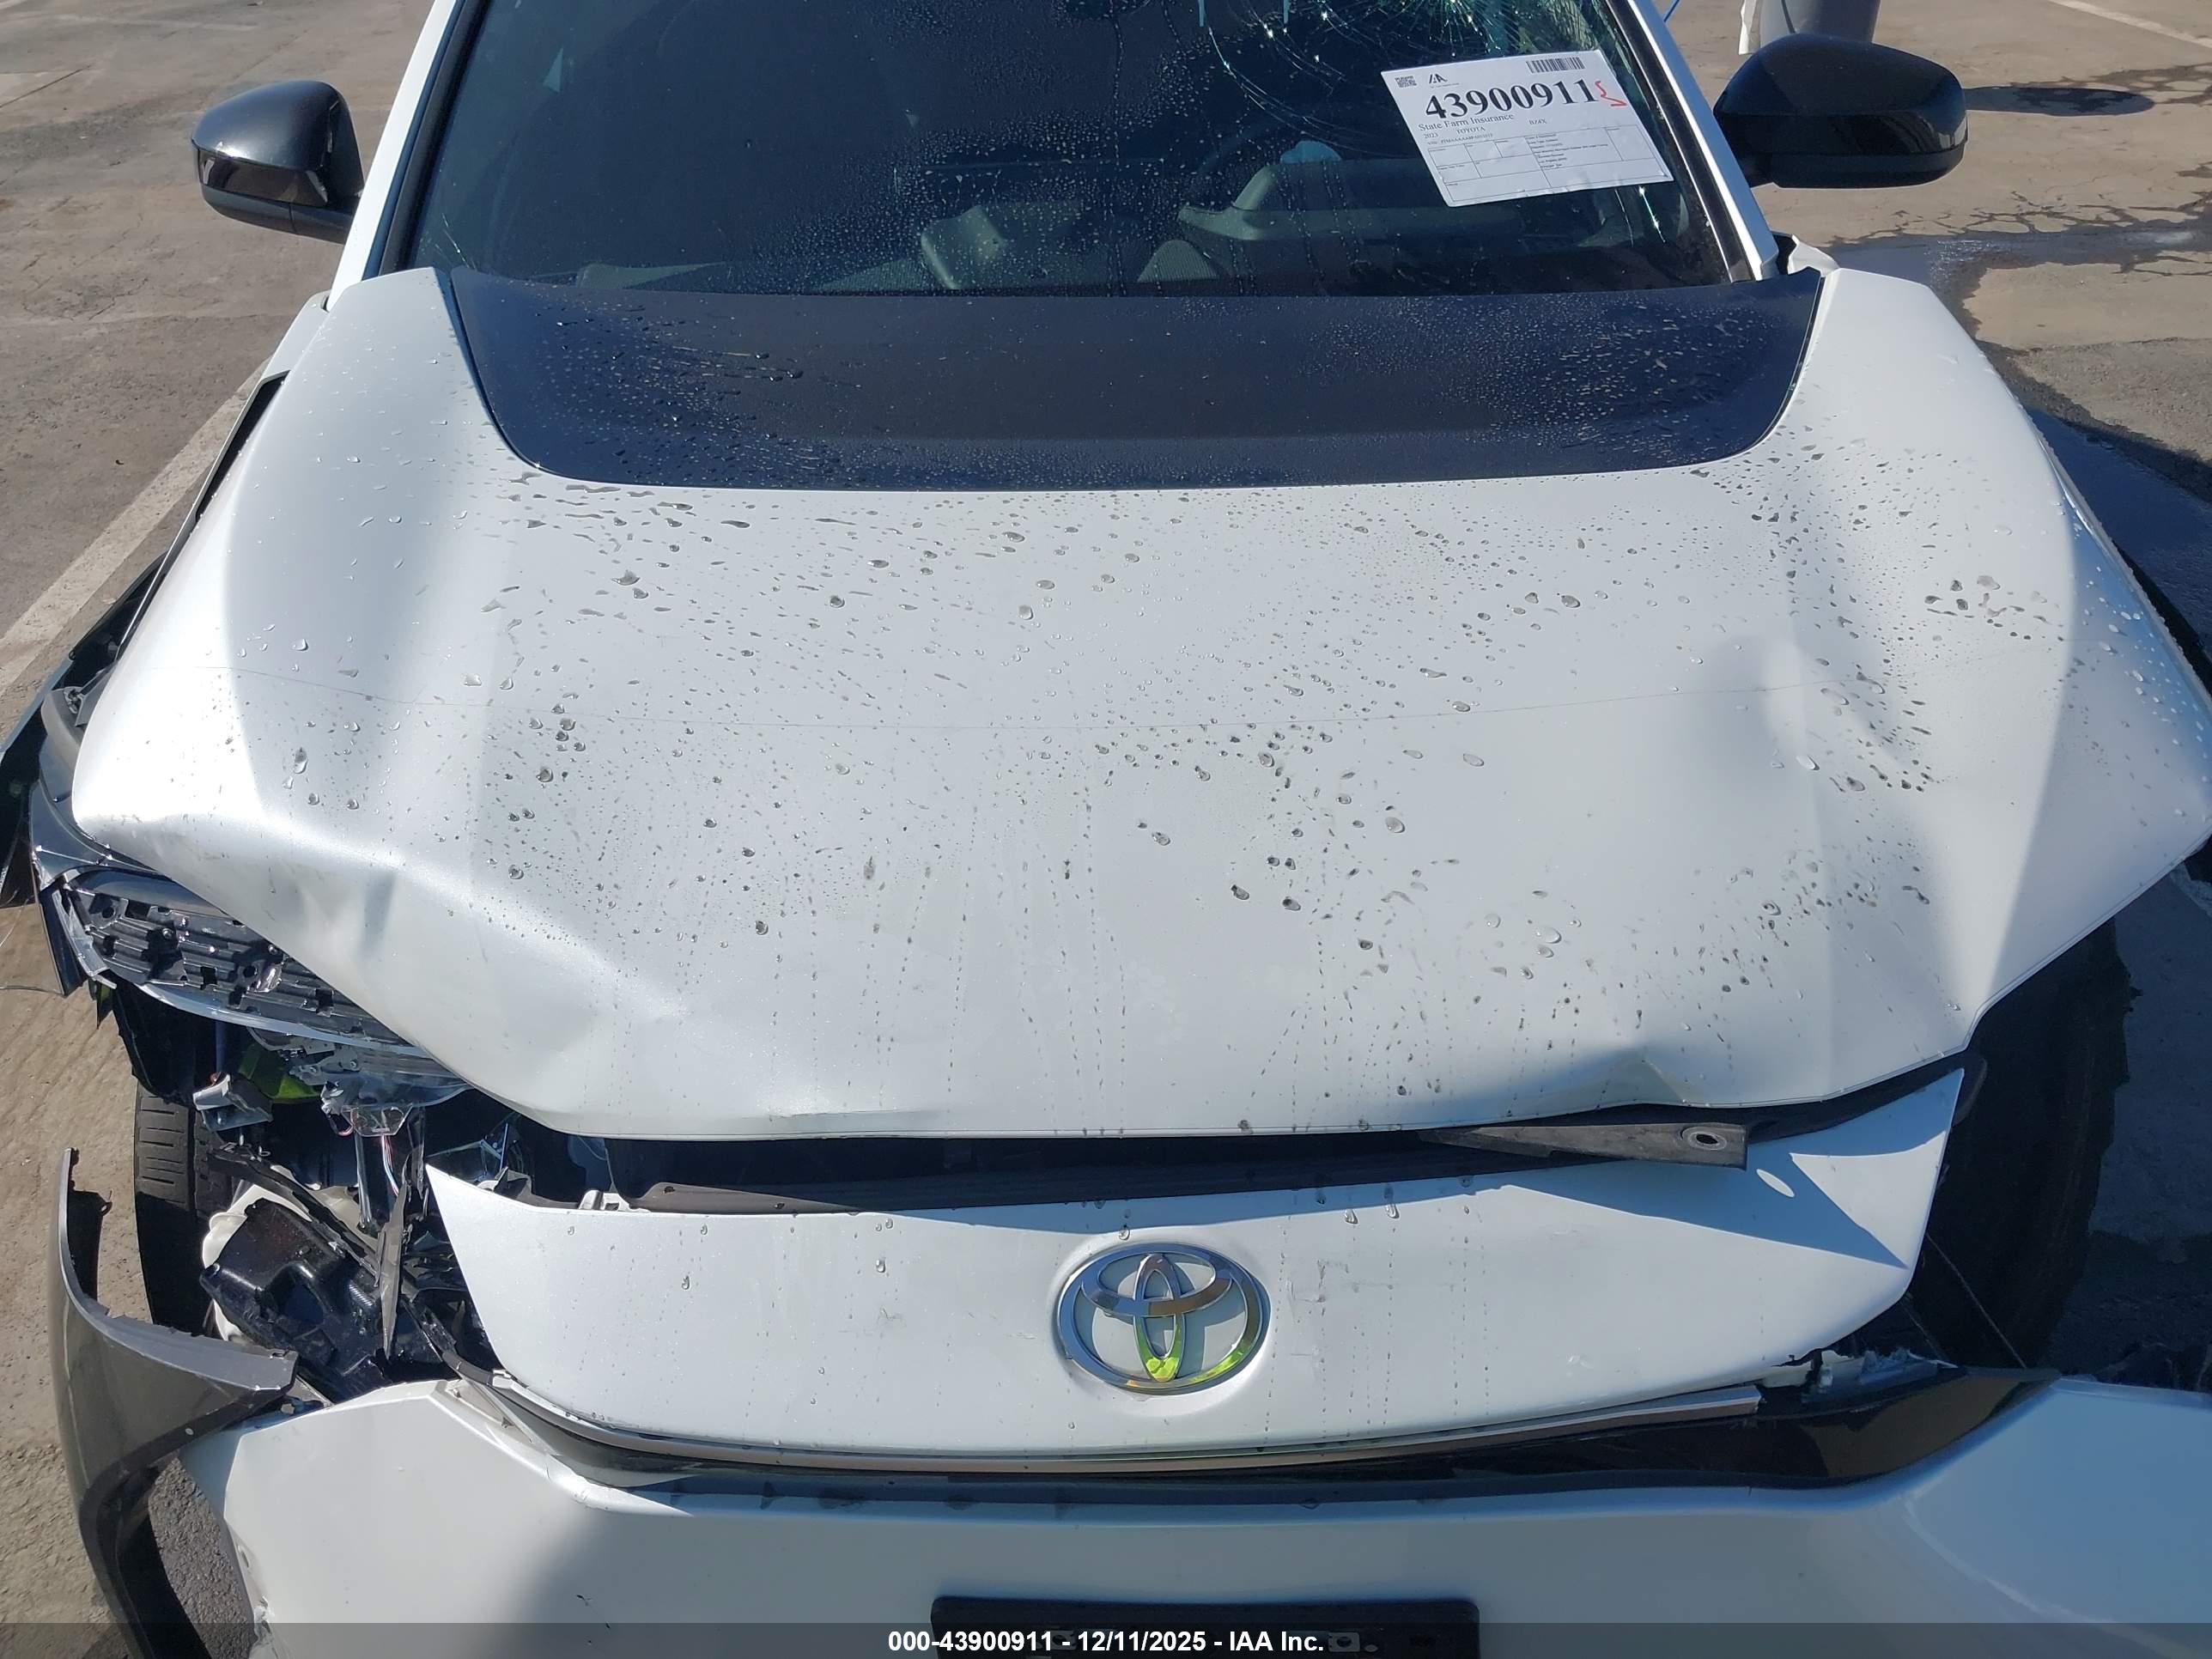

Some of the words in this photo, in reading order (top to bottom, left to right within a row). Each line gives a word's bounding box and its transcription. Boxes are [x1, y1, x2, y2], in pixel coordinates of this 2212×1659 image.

[1425, 79, 1600, 119] 43900911
[1418, 122, 1443, 131] State
[1444, 118, 1470, 128] Farm
[1470, 113, 1515, 125] Insurance
[1456, 126, 1486, 135] TOYOTA
